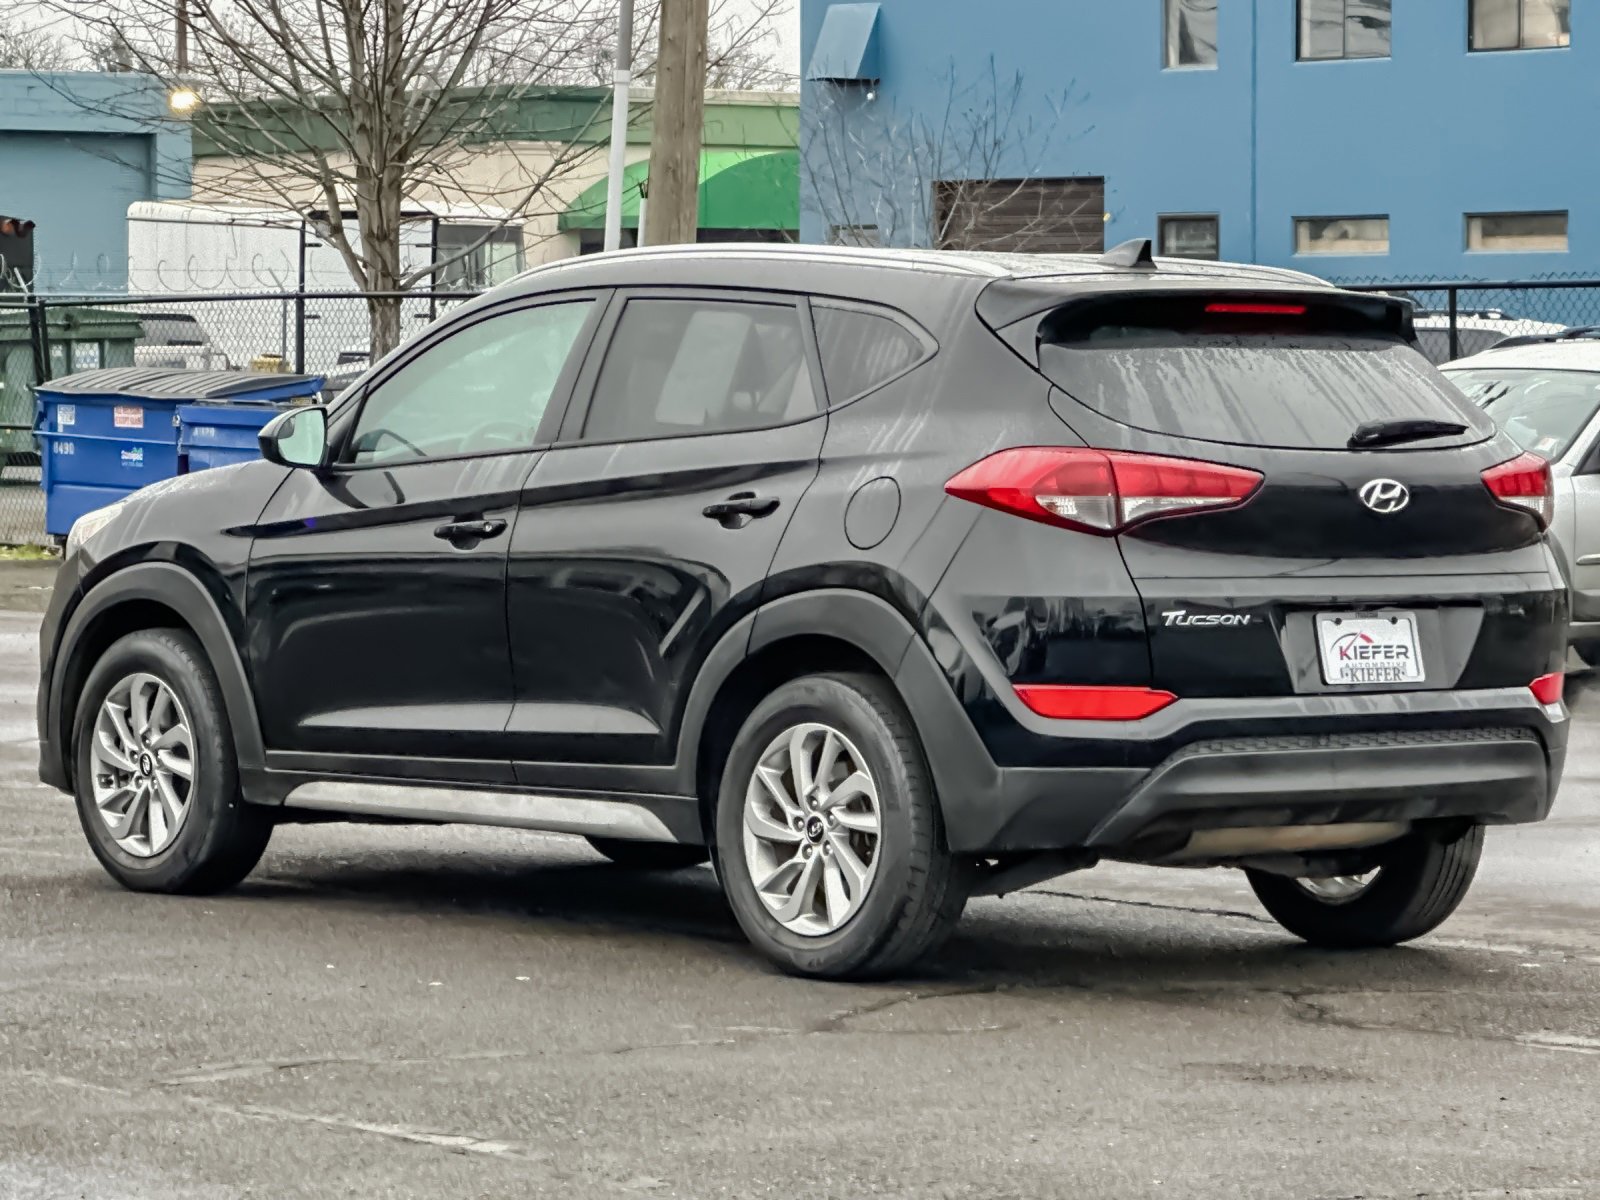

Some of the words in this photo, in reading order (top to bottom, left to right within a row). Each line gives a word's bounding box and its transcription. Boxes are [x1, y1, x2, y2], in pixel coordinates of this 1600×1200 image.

[1162, 610, 1251, 626] TUCSON
[1339, 641, 1410, 661] KIEFER
[1350, 667, 1402, 682] KIEFER
